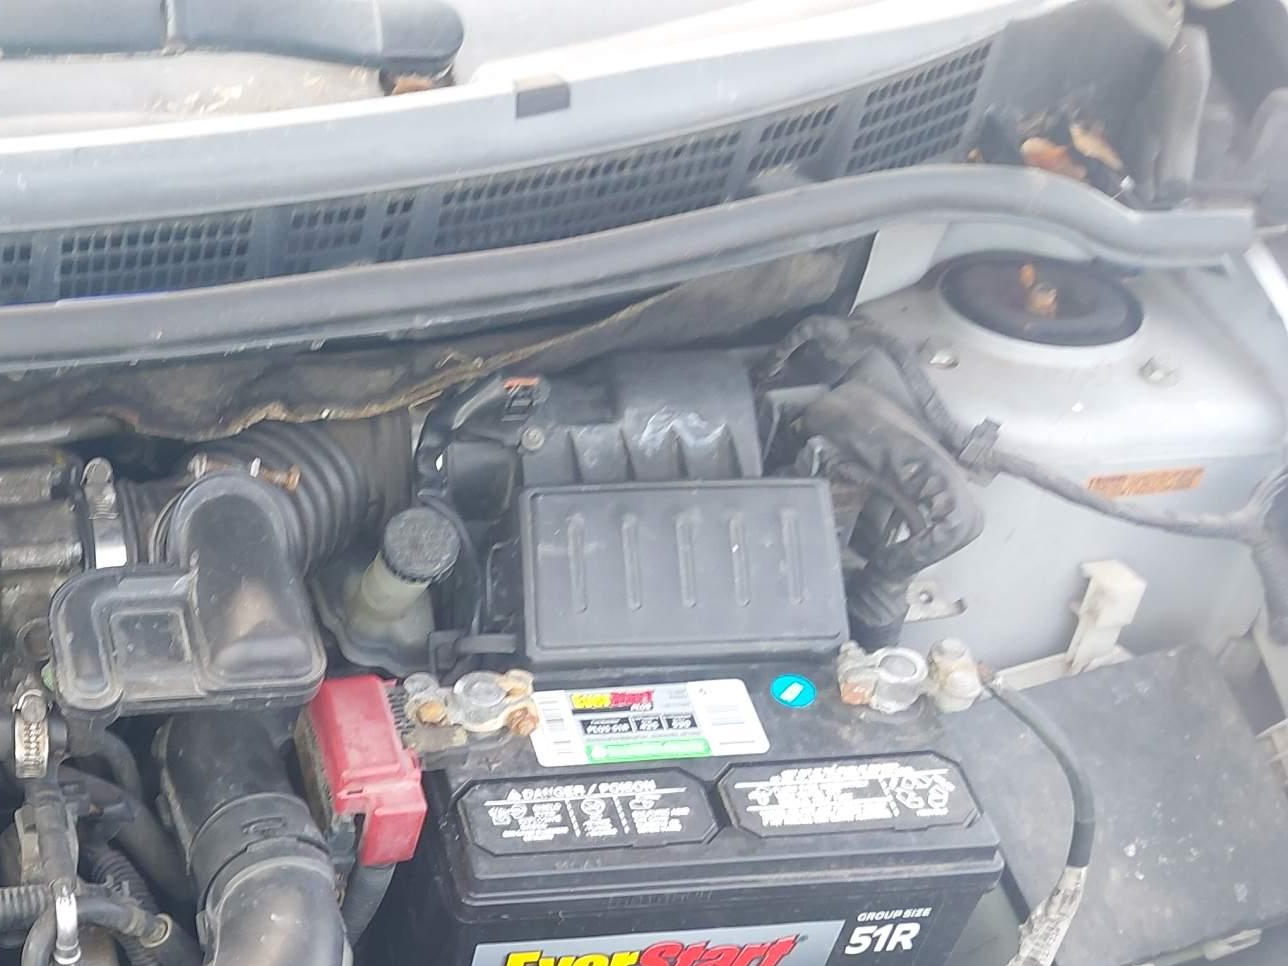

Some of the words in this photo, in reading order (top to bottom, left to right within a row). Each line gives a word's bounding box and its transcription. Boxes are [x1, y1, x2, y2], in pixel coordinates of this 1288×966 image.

[522, 784, 586, 800] DANGER
[598, 779, 656, 795] POISON
[857, 910, 903, 921] GROUP
[902, 907, 932, 918] SIZE
[844, 922, 921, 955] 51R
